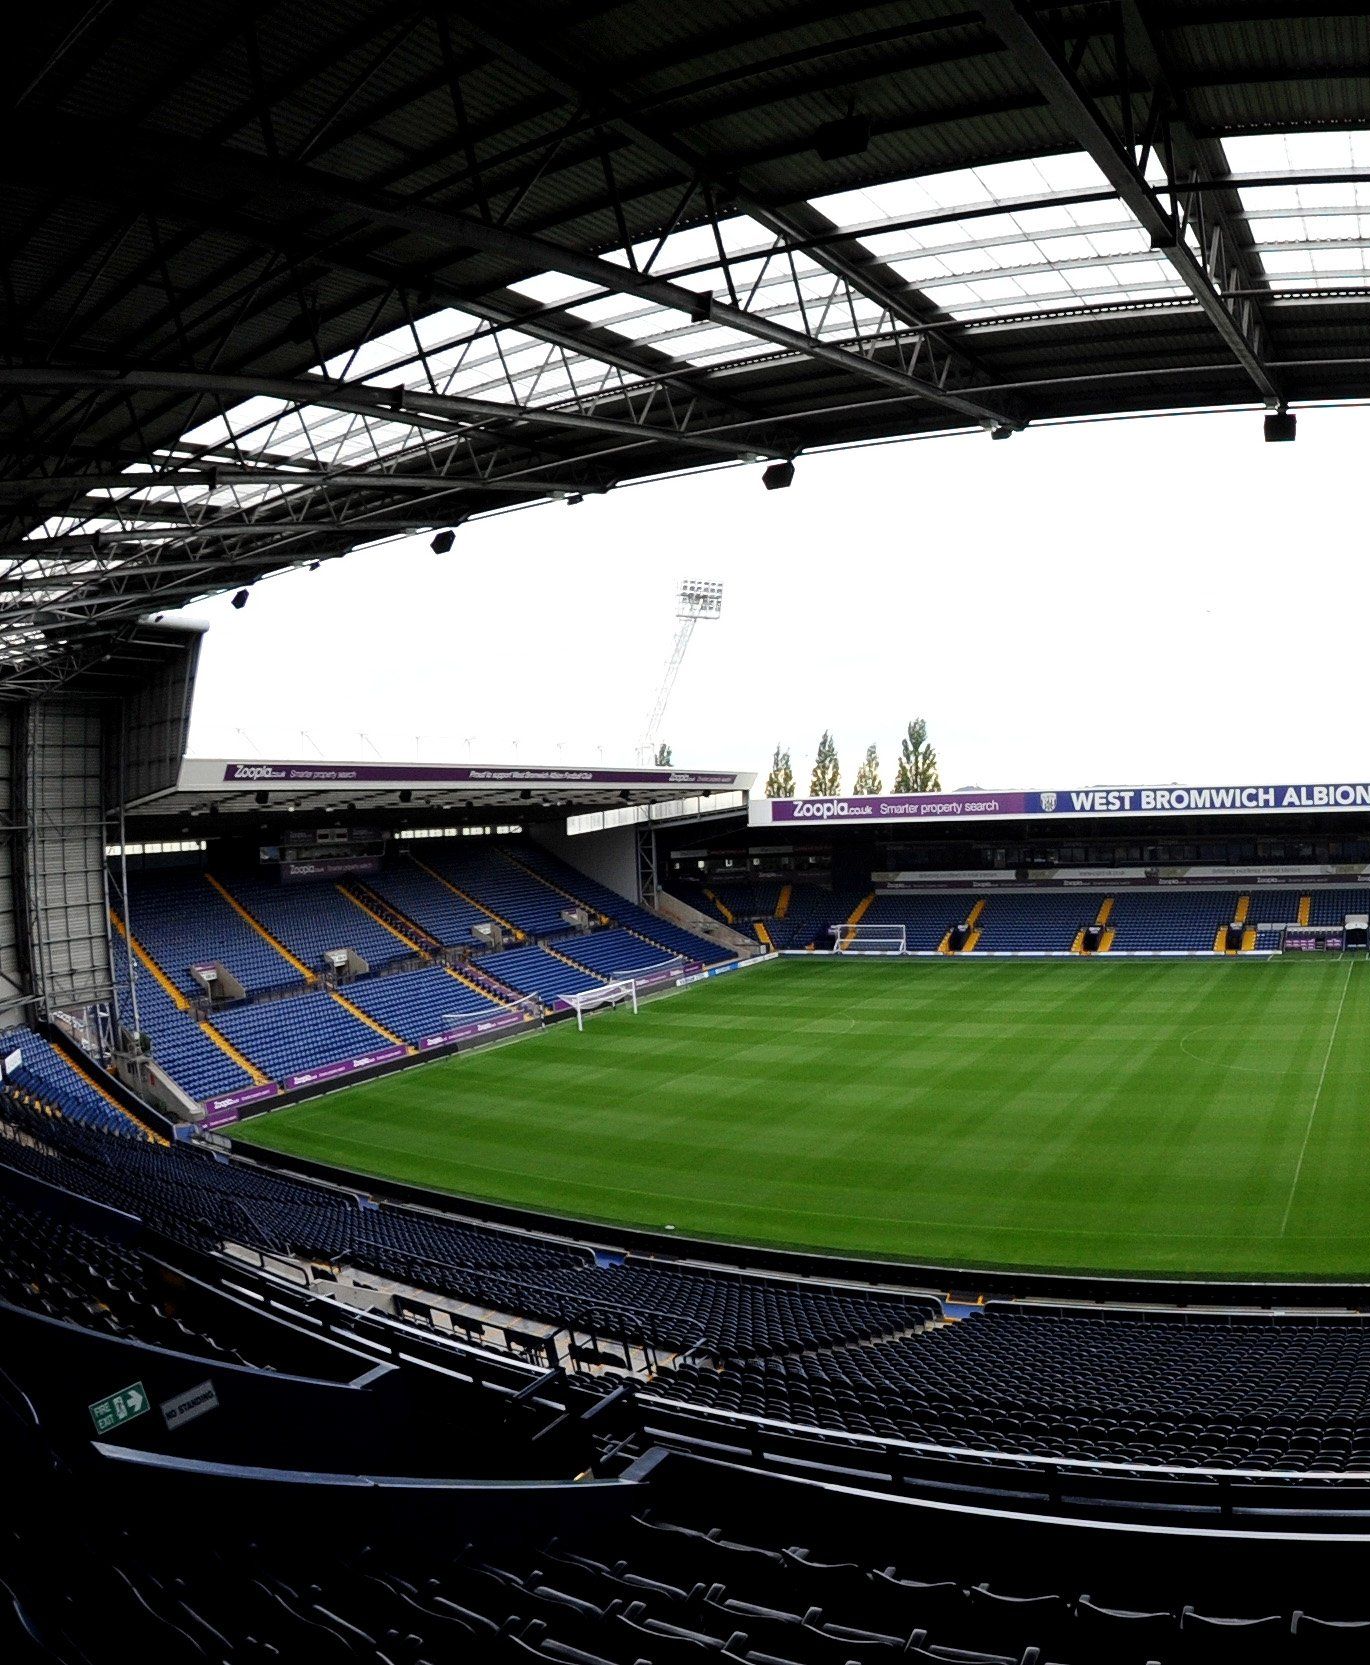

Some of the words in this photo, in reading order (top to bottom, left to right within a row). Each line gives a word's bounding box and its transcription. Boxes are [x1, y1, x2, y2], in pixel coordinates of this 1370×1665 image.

[793, 799, 873, 820] Zoopla.co.uk
[880, 803, 919, 815] Smarter
[921, 802, 963, 815] property
[964, 800, 999, 813] search
[1071, 791, 1134, 811] WEST
[1141, 788, 1275, 810] BROMWICH
[93, 1402, 111, 1418] FIRE
[165, 1409, 177, 1421] NO
[178, 1390, 214, 1415] STANDING
